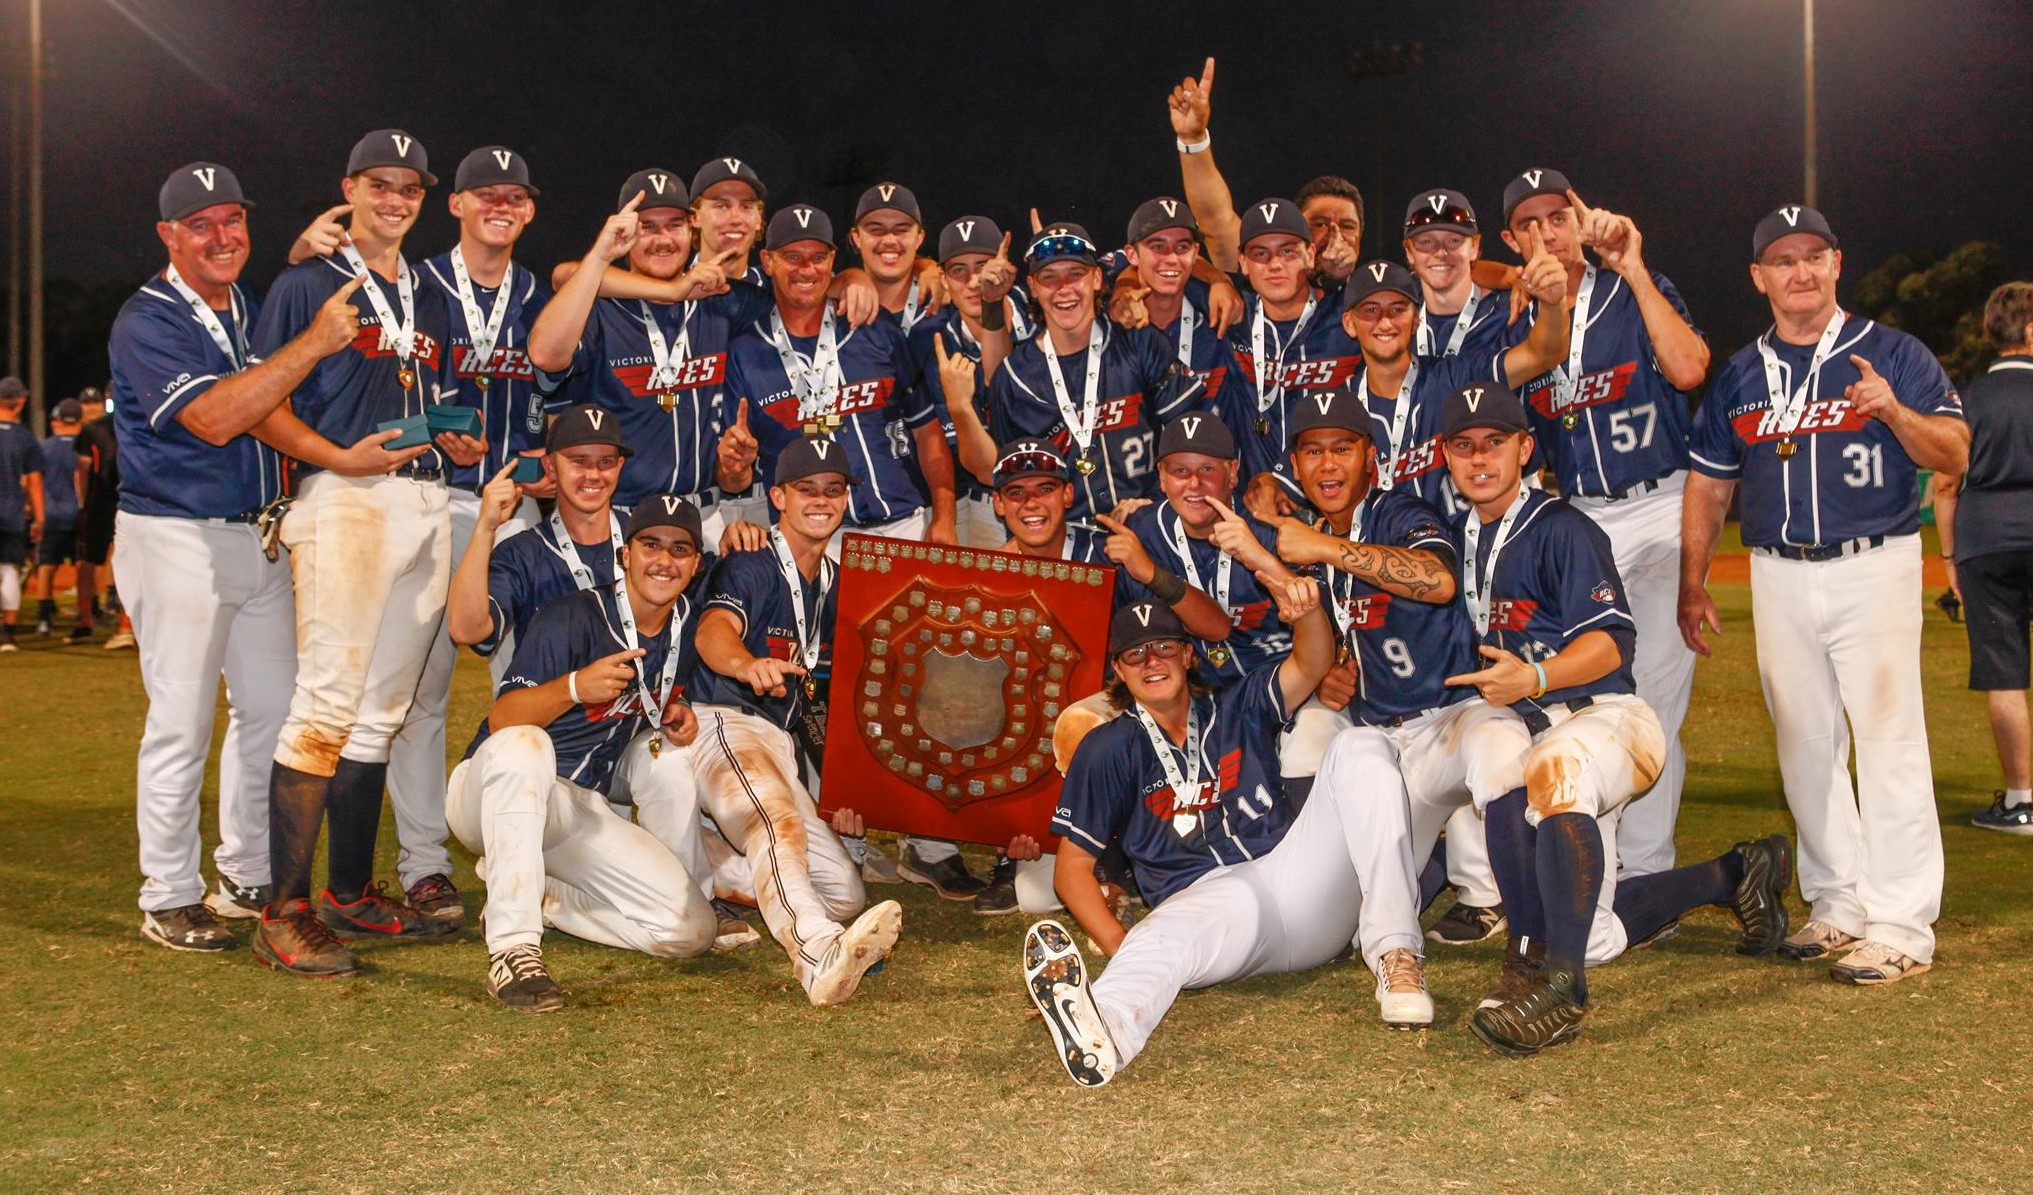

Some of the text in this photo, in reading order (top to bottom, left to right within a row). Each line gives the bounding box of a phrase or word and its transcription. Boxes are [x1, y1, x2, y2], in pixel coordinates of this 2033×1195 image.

[390, 134, 412, 158] V
[491, 150, 512, 171] V
[722, 158, 742, 175] V
[192, 167, 216, 192] V
[647, 174, 668, 195] V
[1522, 169, 1543, 189] V
[877, 185, 896, 202] V
[1427, 194, 1448, 215] V
[792, 208, 813, 229] V
[1159, 200, 1178, 218] V
[1259, 202, 1279, 224] V
[1778, 206, 1802, 228] V
[955, 220, 976, 242] V
[1368, 262, 1389, 283] V
[1313, 392, 1336, 416] V
[1462, 388, 1485, 413] V
[584, 409, 604, 431] V
[1180, 416, 1202, 440] V
[1609, 400, 1658, 454] 57
[809, 439, 830, 460] V
[1120, 431, 1155, 480] 27
[1842, 443, 1885, 488] 31
[661, 495, 683, 516] V
[1132, 604, 1153, 627] V
[1381, 636, 1417, 679] 9
[1237, 783, 1273, 821] 11
